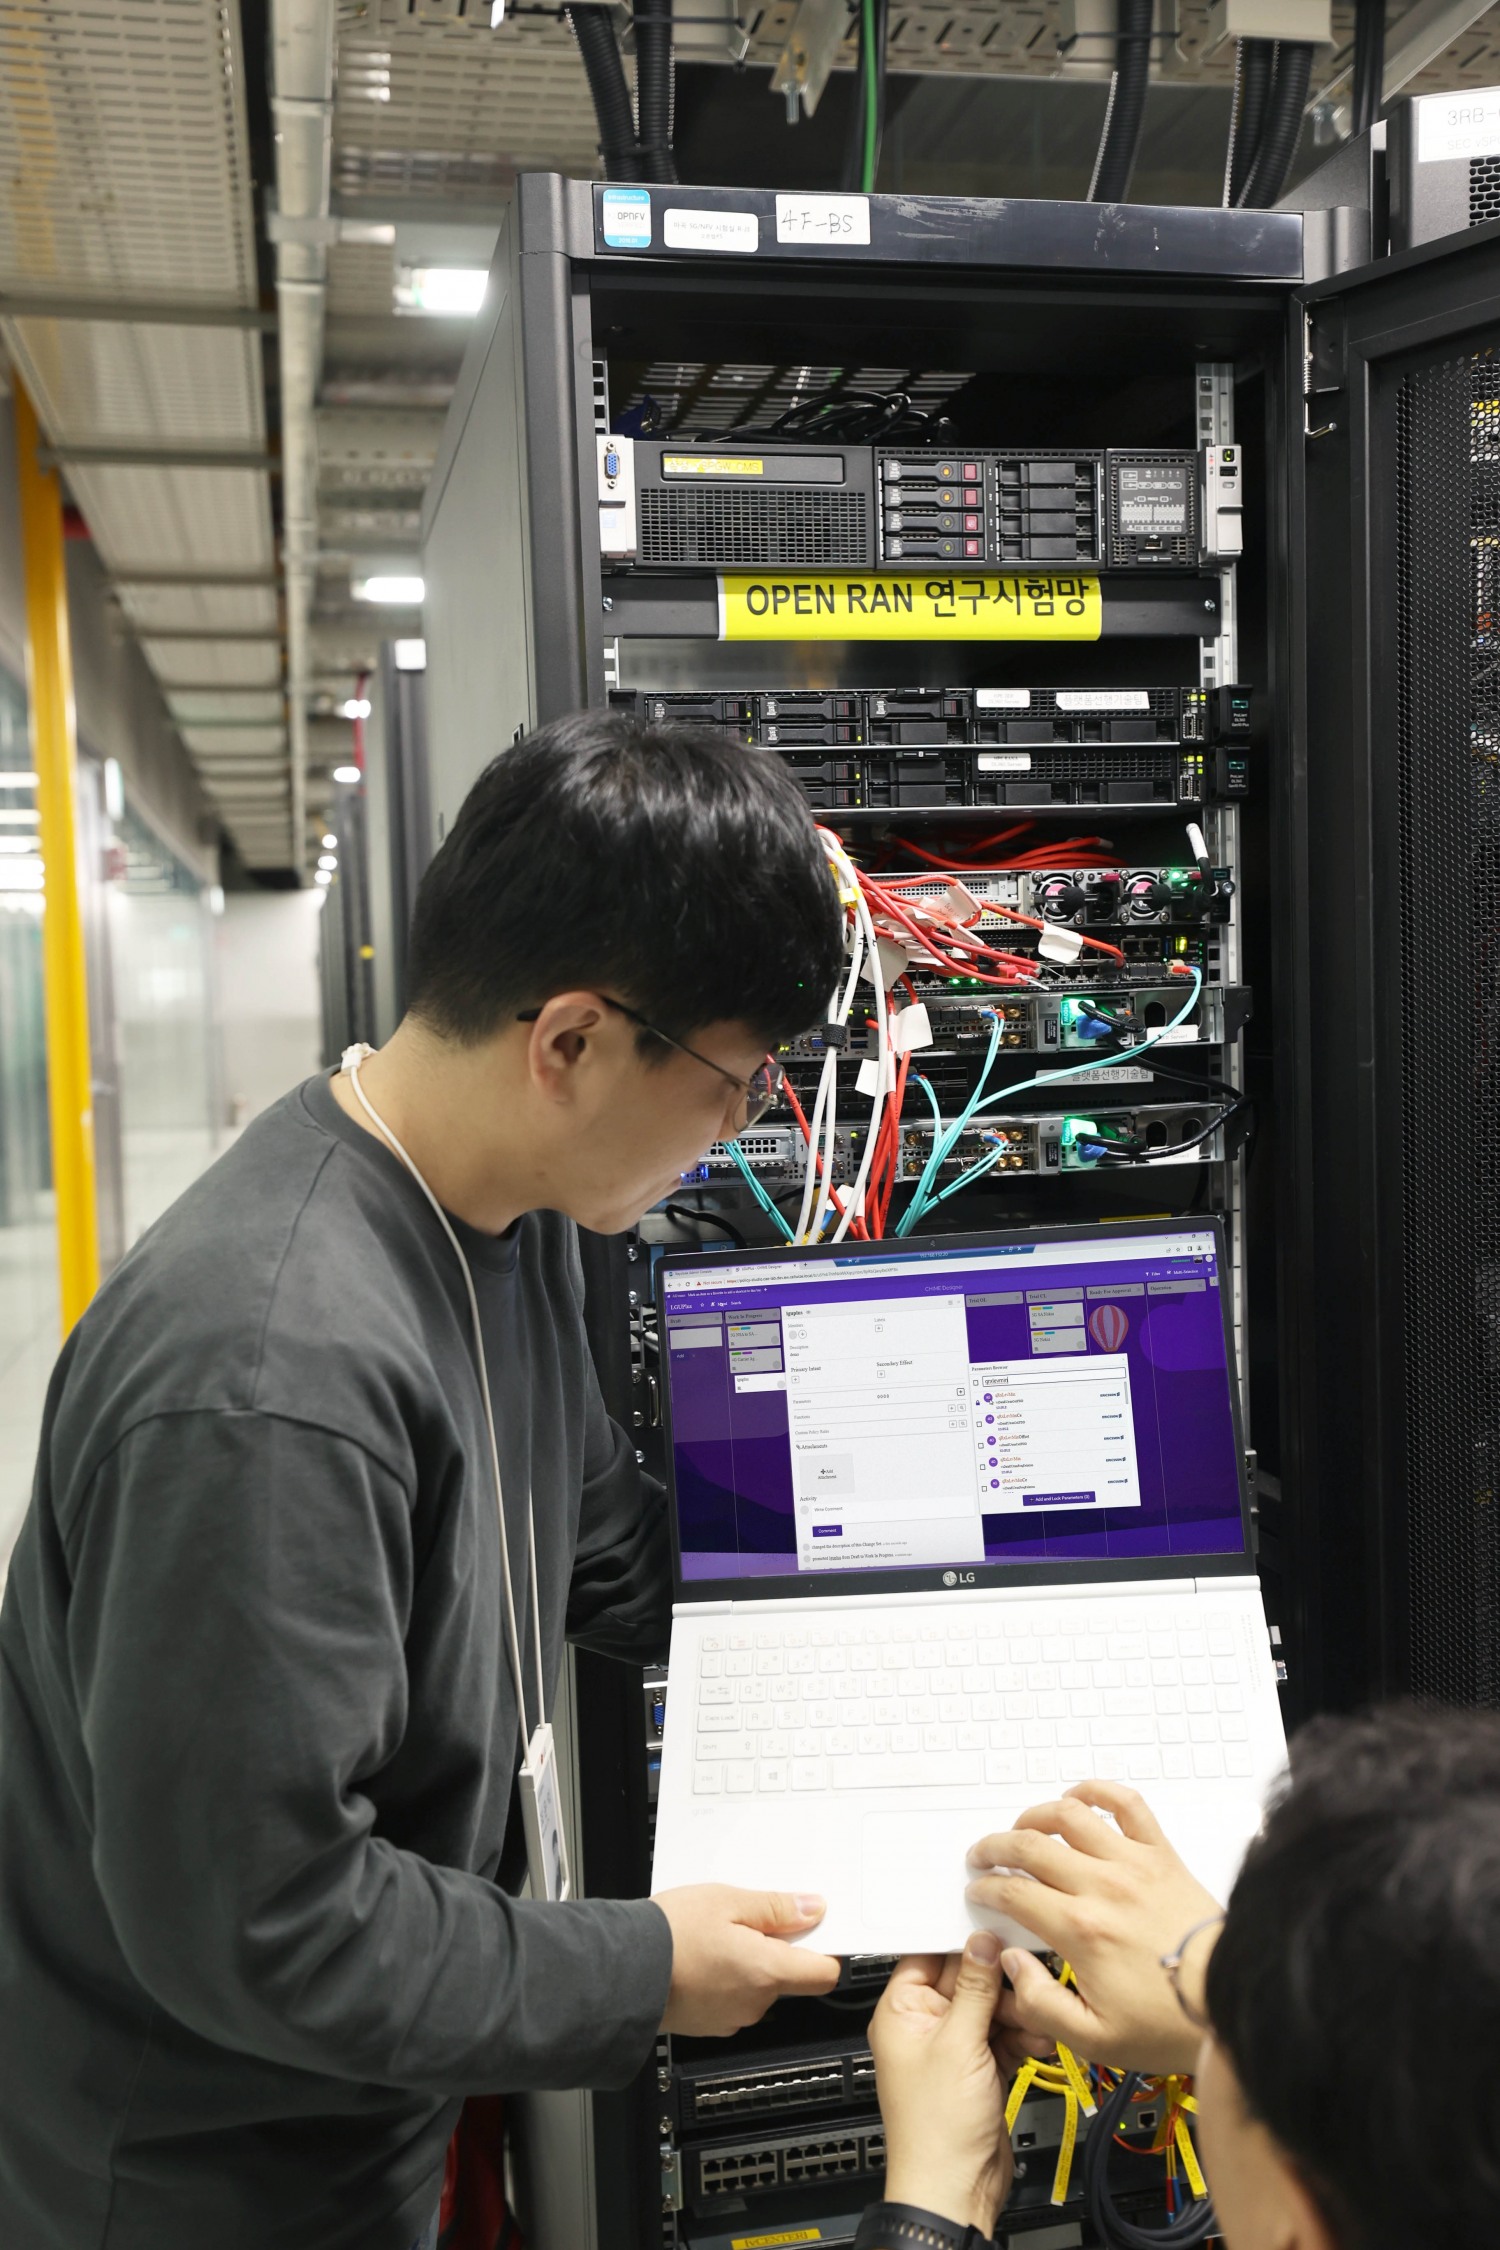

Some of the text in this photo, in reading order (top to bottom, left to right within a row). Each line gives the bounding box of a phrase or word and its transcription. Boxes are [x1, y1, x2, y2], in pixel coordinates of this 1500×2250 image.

[1448, 106, 1500, 126] 3RB-
[782, 209, 853, 235] 4F-BS
[746, 577, 1090, 618] OPEN RAN 연구시험망
[942, 1284, 963, 1292] Designer
[959, 1572, 975, 1583] LG
